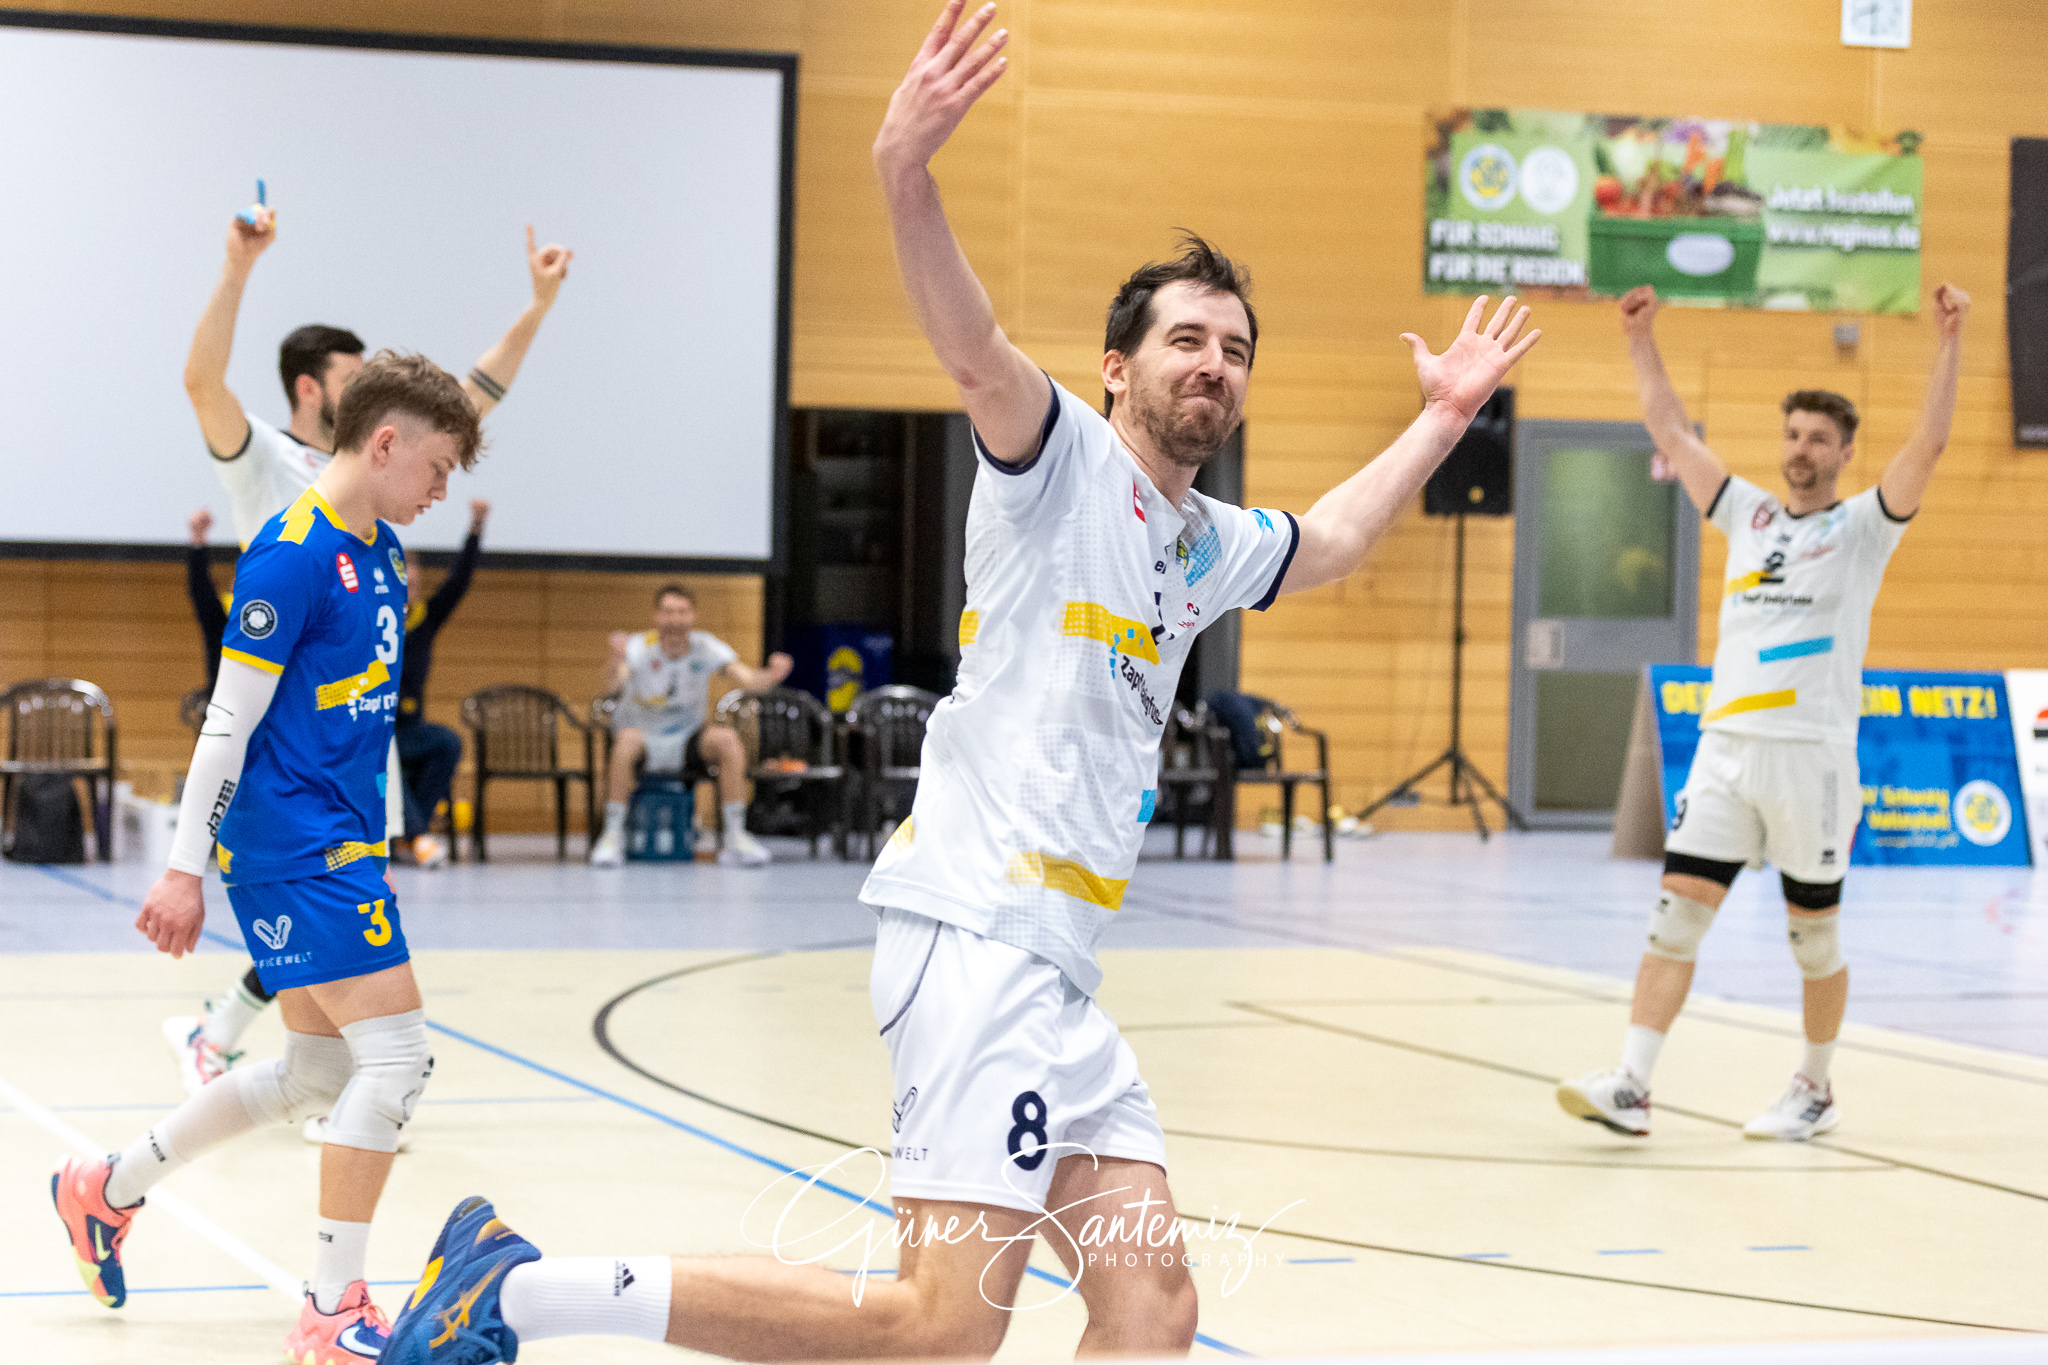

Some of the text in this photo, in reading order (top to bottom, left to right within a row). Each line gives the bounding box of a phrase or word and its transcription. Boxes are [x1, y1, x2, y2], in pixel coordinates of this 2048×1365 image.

[374, 605, 398, 665] 3
[358, 899, 392, 947] 3
[1007, 1090, 1048, 1171] 8
